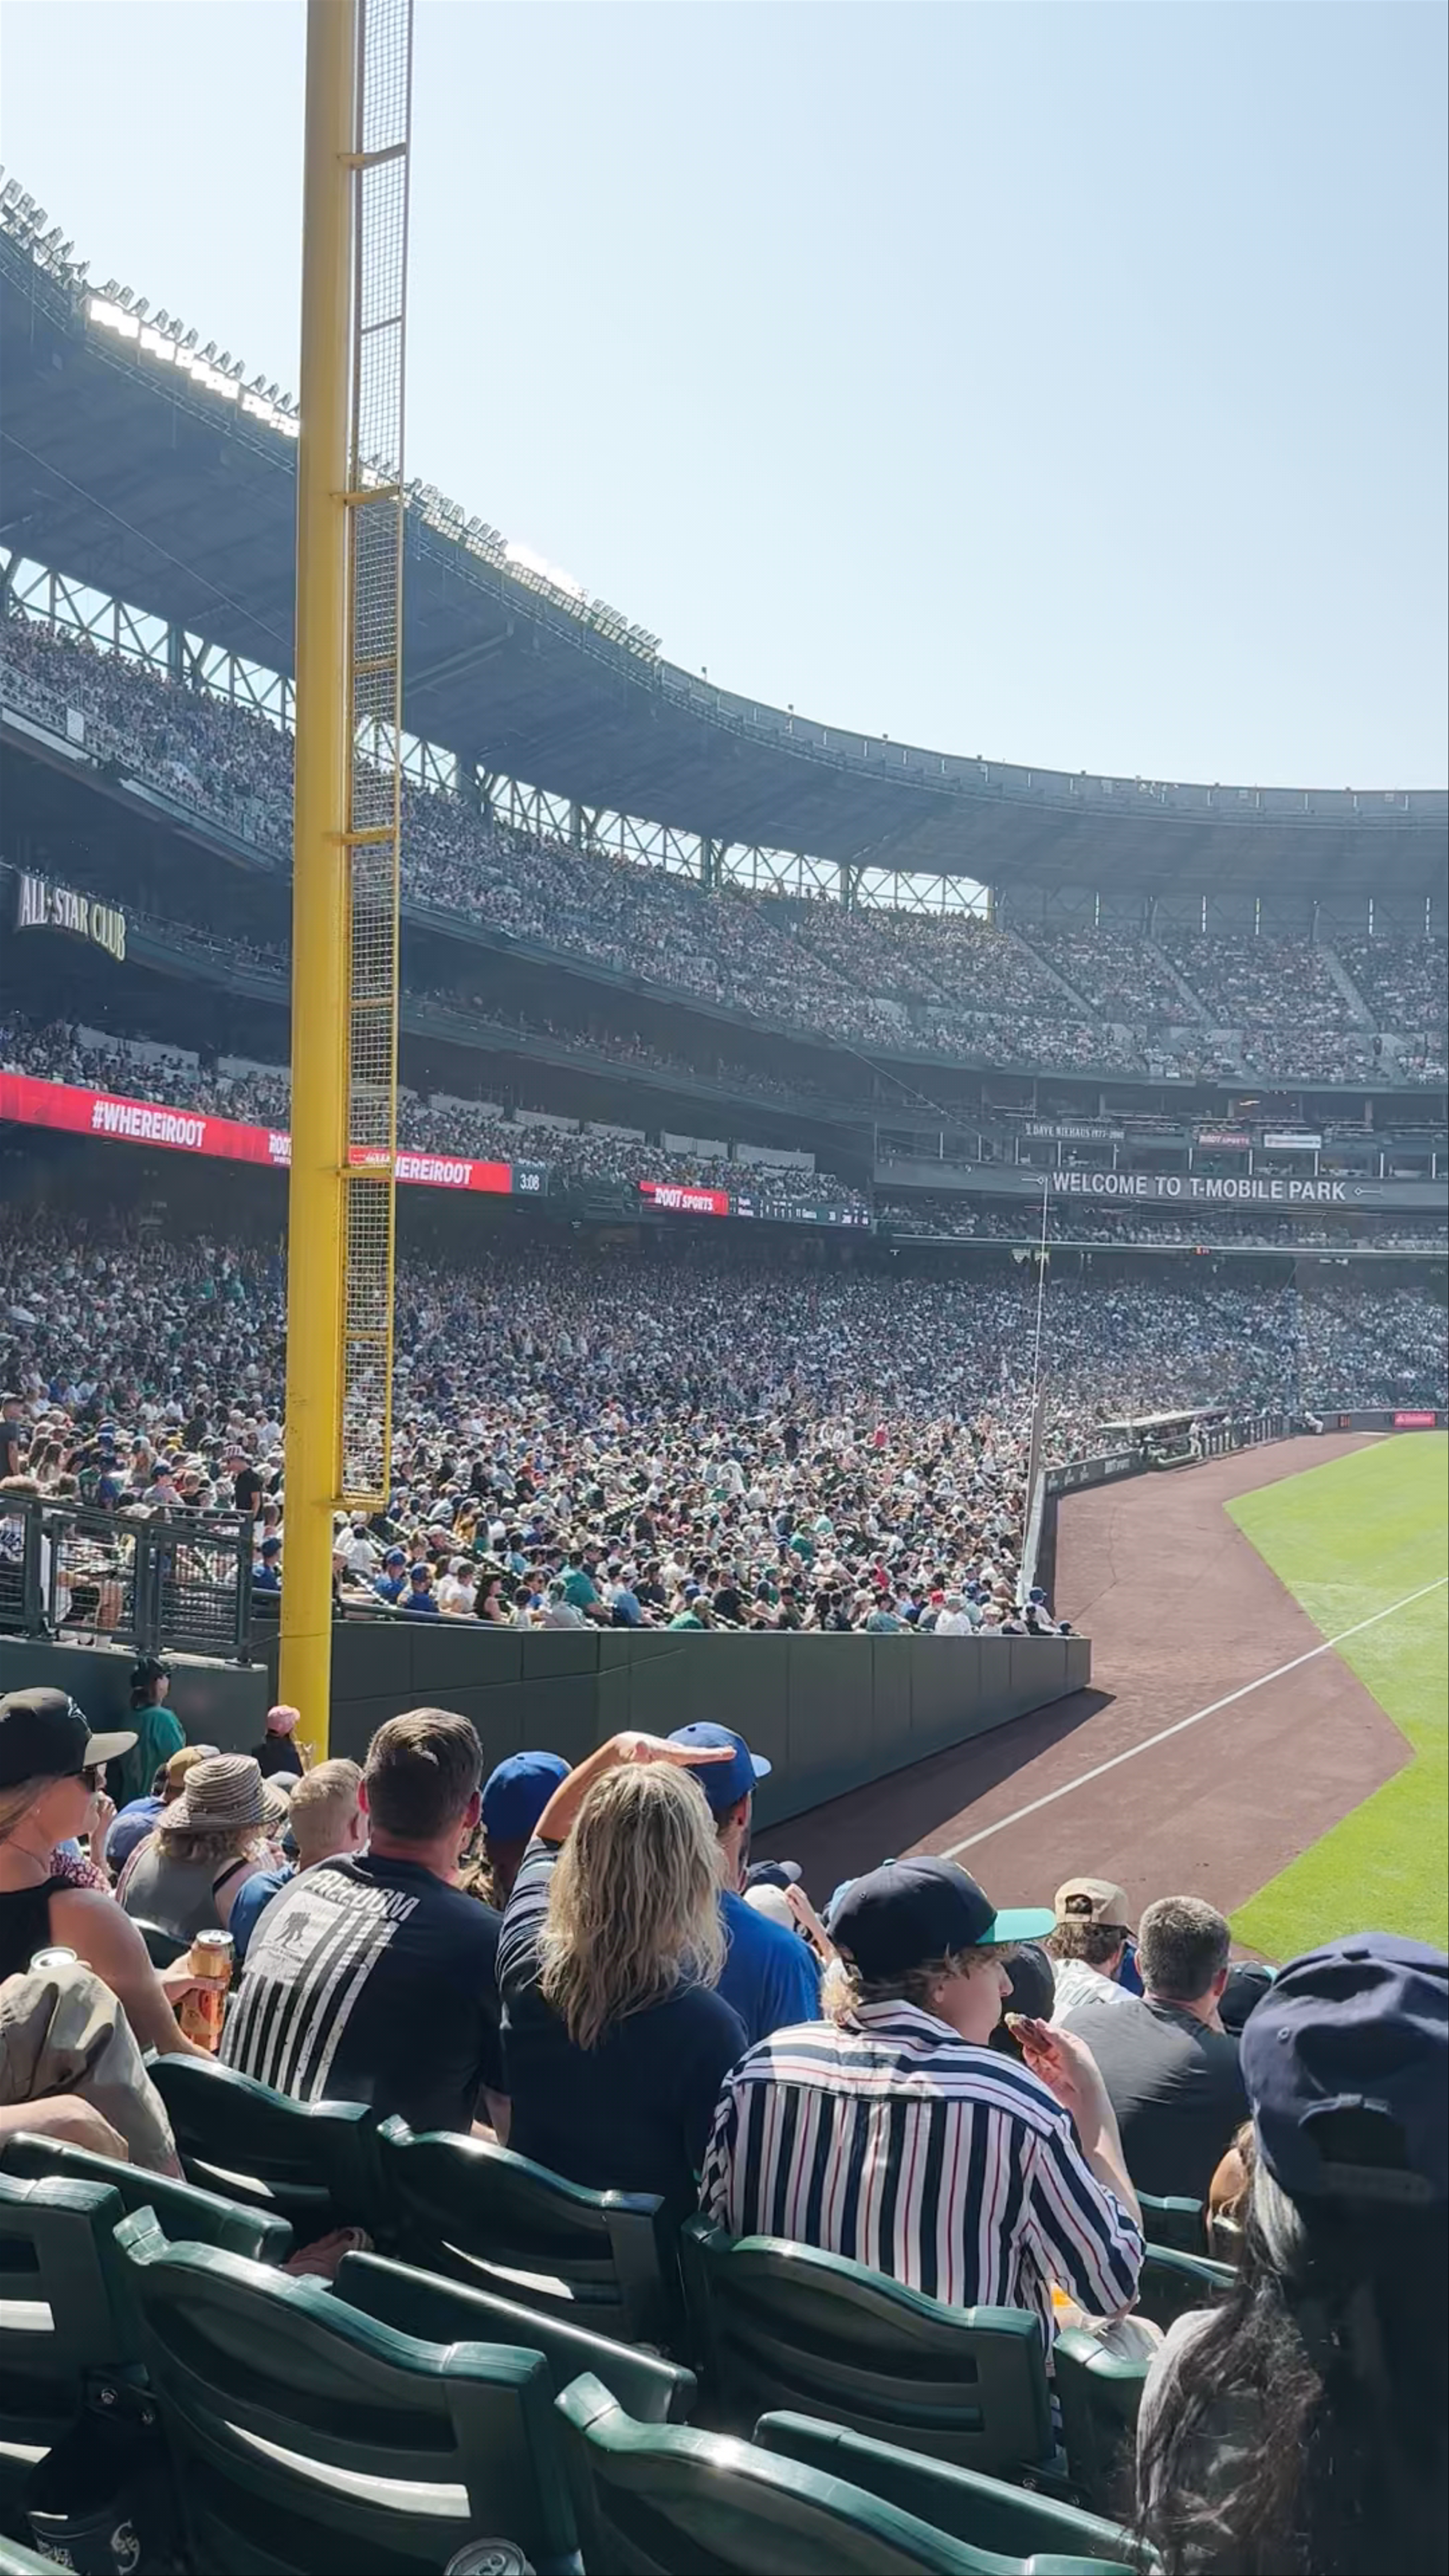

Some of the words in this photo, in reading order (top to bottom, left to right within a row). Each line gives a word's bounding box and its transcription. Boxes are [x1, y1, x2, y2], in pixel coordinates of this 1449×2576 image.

[20, 875, 48, 926] ALL
[54, 887, 88, 934] STAR
[91, 903, 126, 961] CLUB
[520, 1173, 539, 1191] 3:08
[1053, 1172, 1148, 1195] WELCOME
[1155, 1176, 1180, 1196] TO
[1189, 1178, 1283, 1199] T-MOBILE
[1289, 1181, 1346, 1200] PARK
[655, 1187, 683, 1207] ROOT
[682, 1194, 713, 1211] SPORTS
[301, 1869, 421, 1922] FREEDOM
